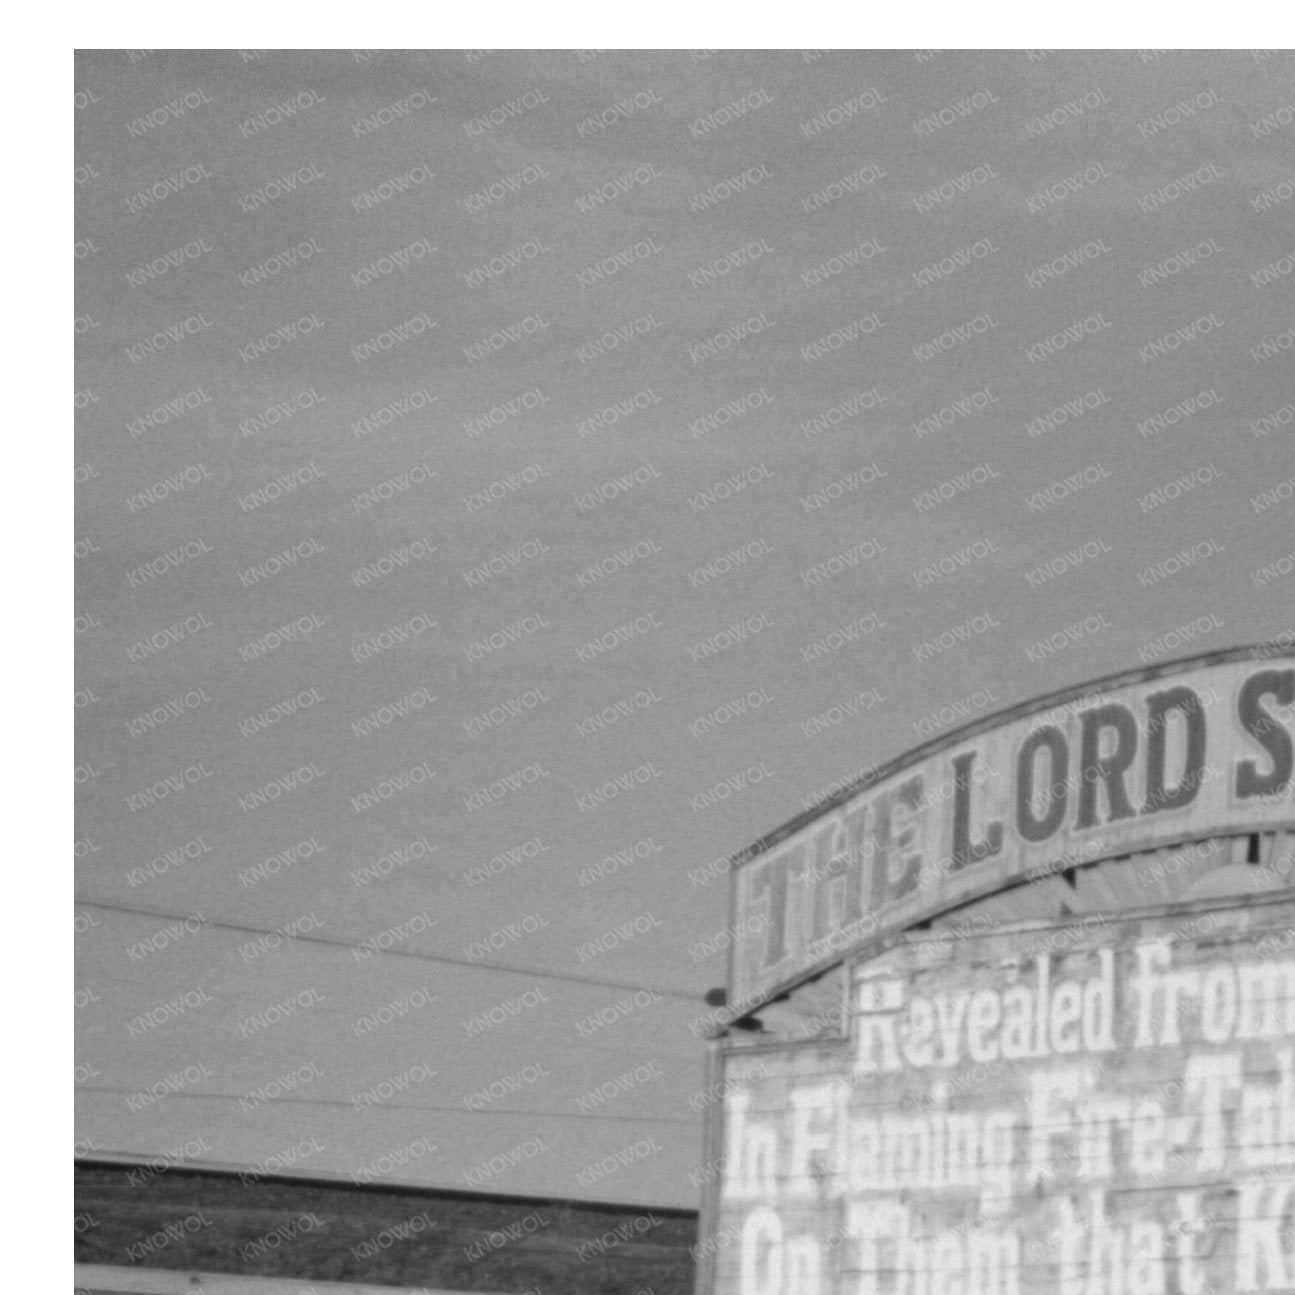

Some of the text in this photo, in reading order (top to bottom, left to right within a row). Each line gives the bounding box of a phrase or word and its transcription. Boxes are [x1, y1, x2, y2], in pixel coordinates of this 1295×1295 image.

[749, 774, 923, 973] THE
[950, 685, 1206, 872] LORD
[854, 948, 1117, 1071] Revealed
[721, 1090, 776, 1197] In
[790, 1080, 1019, 1215] Flaming
